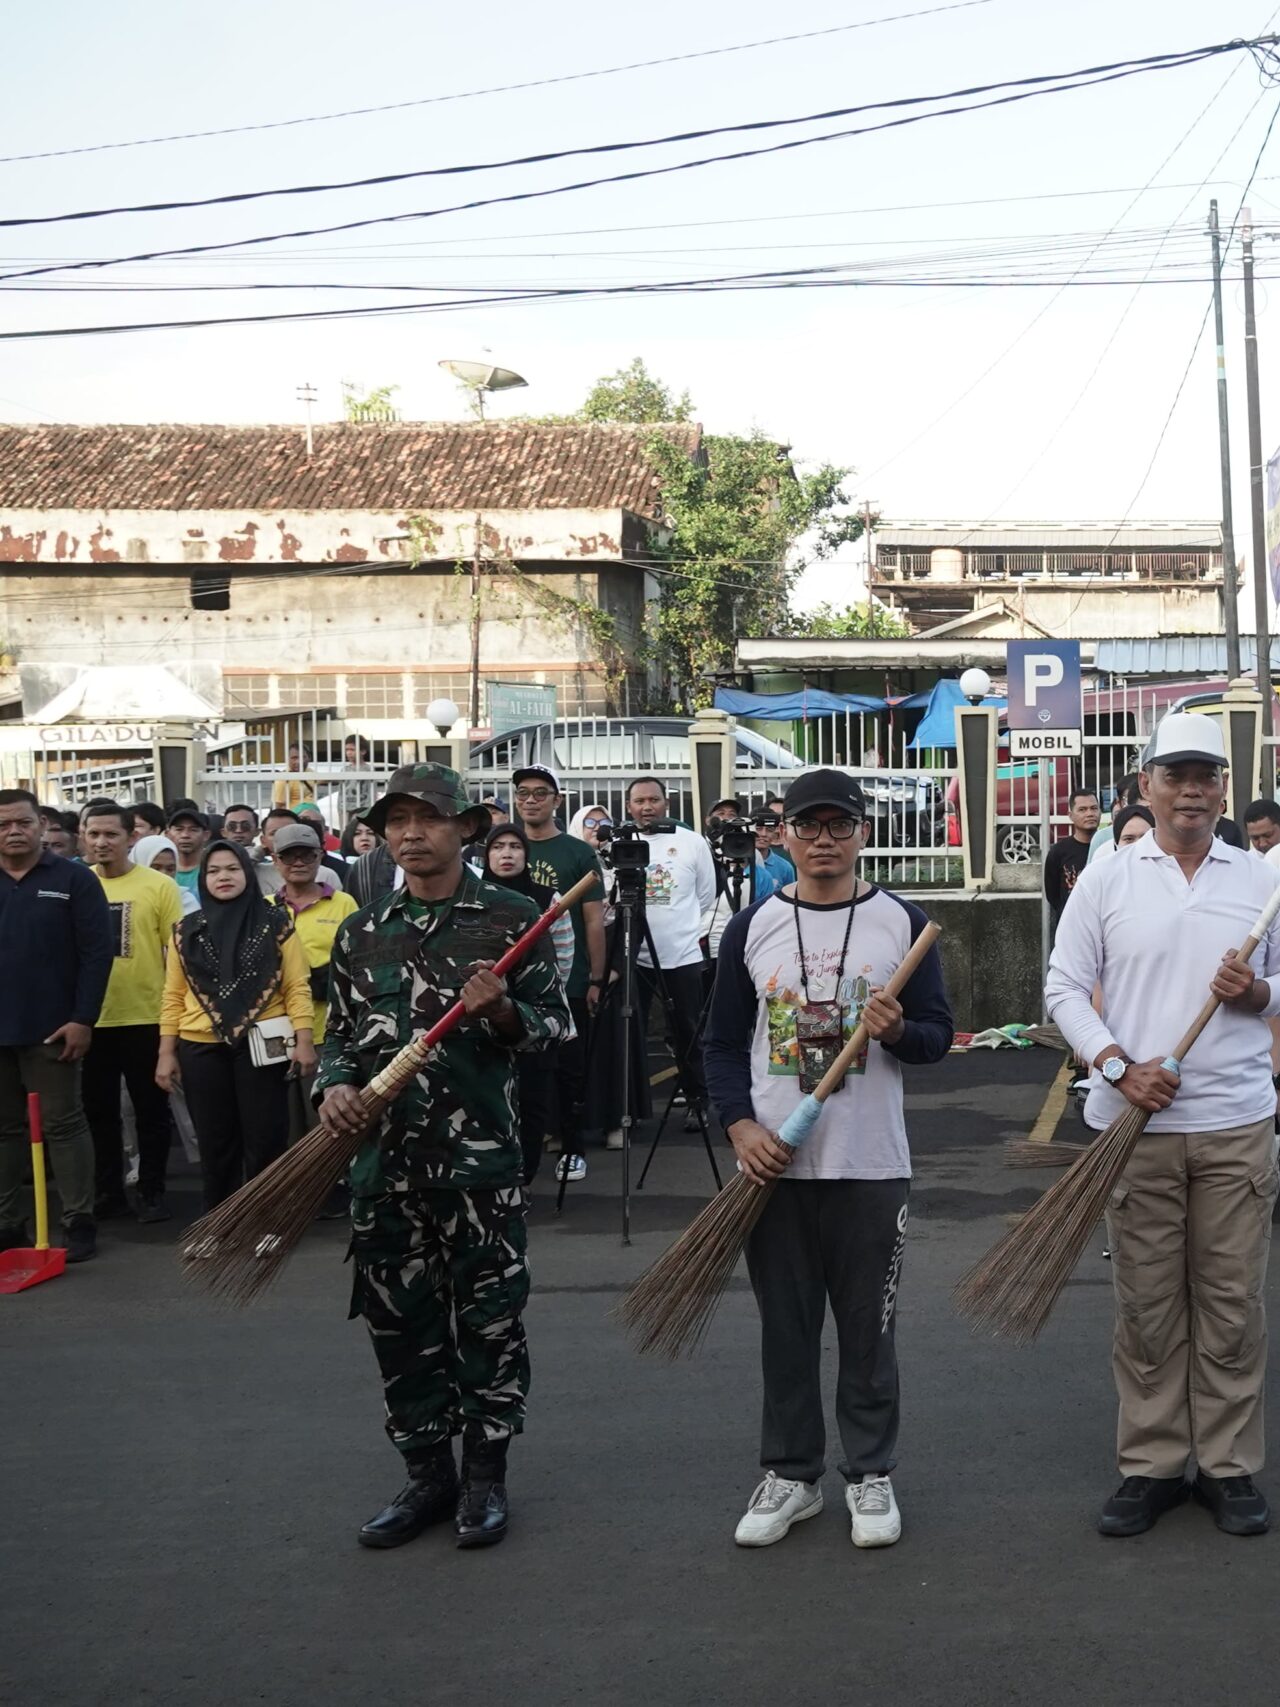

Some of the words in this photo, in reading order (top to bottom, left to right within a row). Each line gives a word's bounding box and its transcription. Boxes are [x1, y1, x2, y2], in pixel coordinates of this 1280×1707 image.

[1023, 654, 1064, 706] P
[1019, 737, 1072, 749] MOBIL
[793, 951, 810, 964] Tie
[820, 948, 849, 963] Exploe
[816, 961, 840, 978] Jungl
